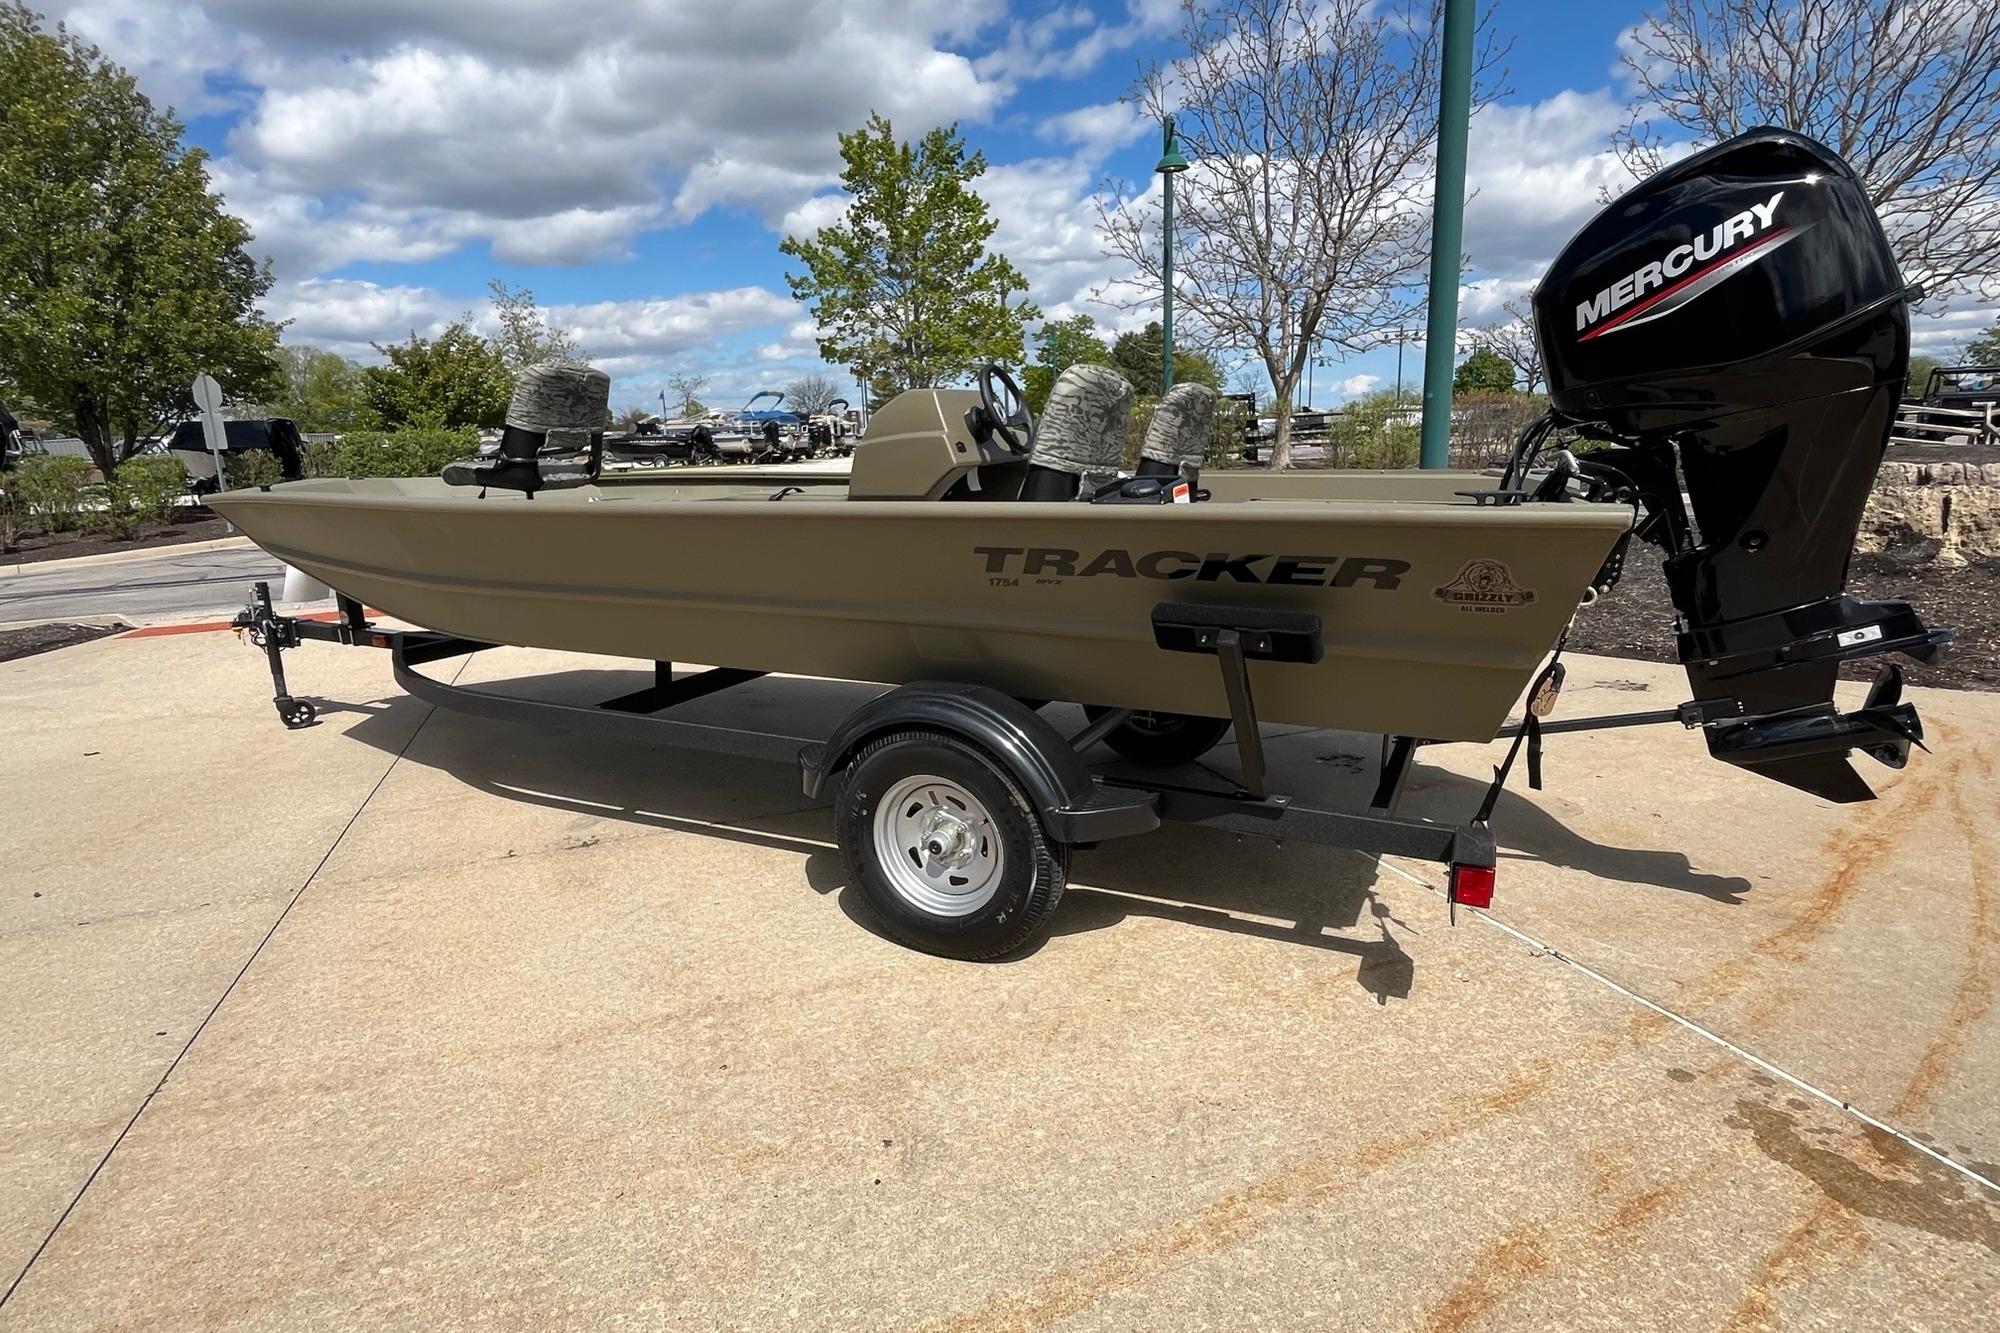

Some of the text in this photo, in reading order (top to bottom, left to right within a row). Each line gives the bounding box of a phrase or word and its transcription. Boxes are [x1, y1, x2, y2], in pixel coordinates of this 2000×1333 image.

[1576, 191, 1784, 331] MERCURY
[973, 547, 1411, 590] TRACKER
[988, 577, 1020, 587] 1754
[1454, 592, 1515, 602] GRIZZLY
